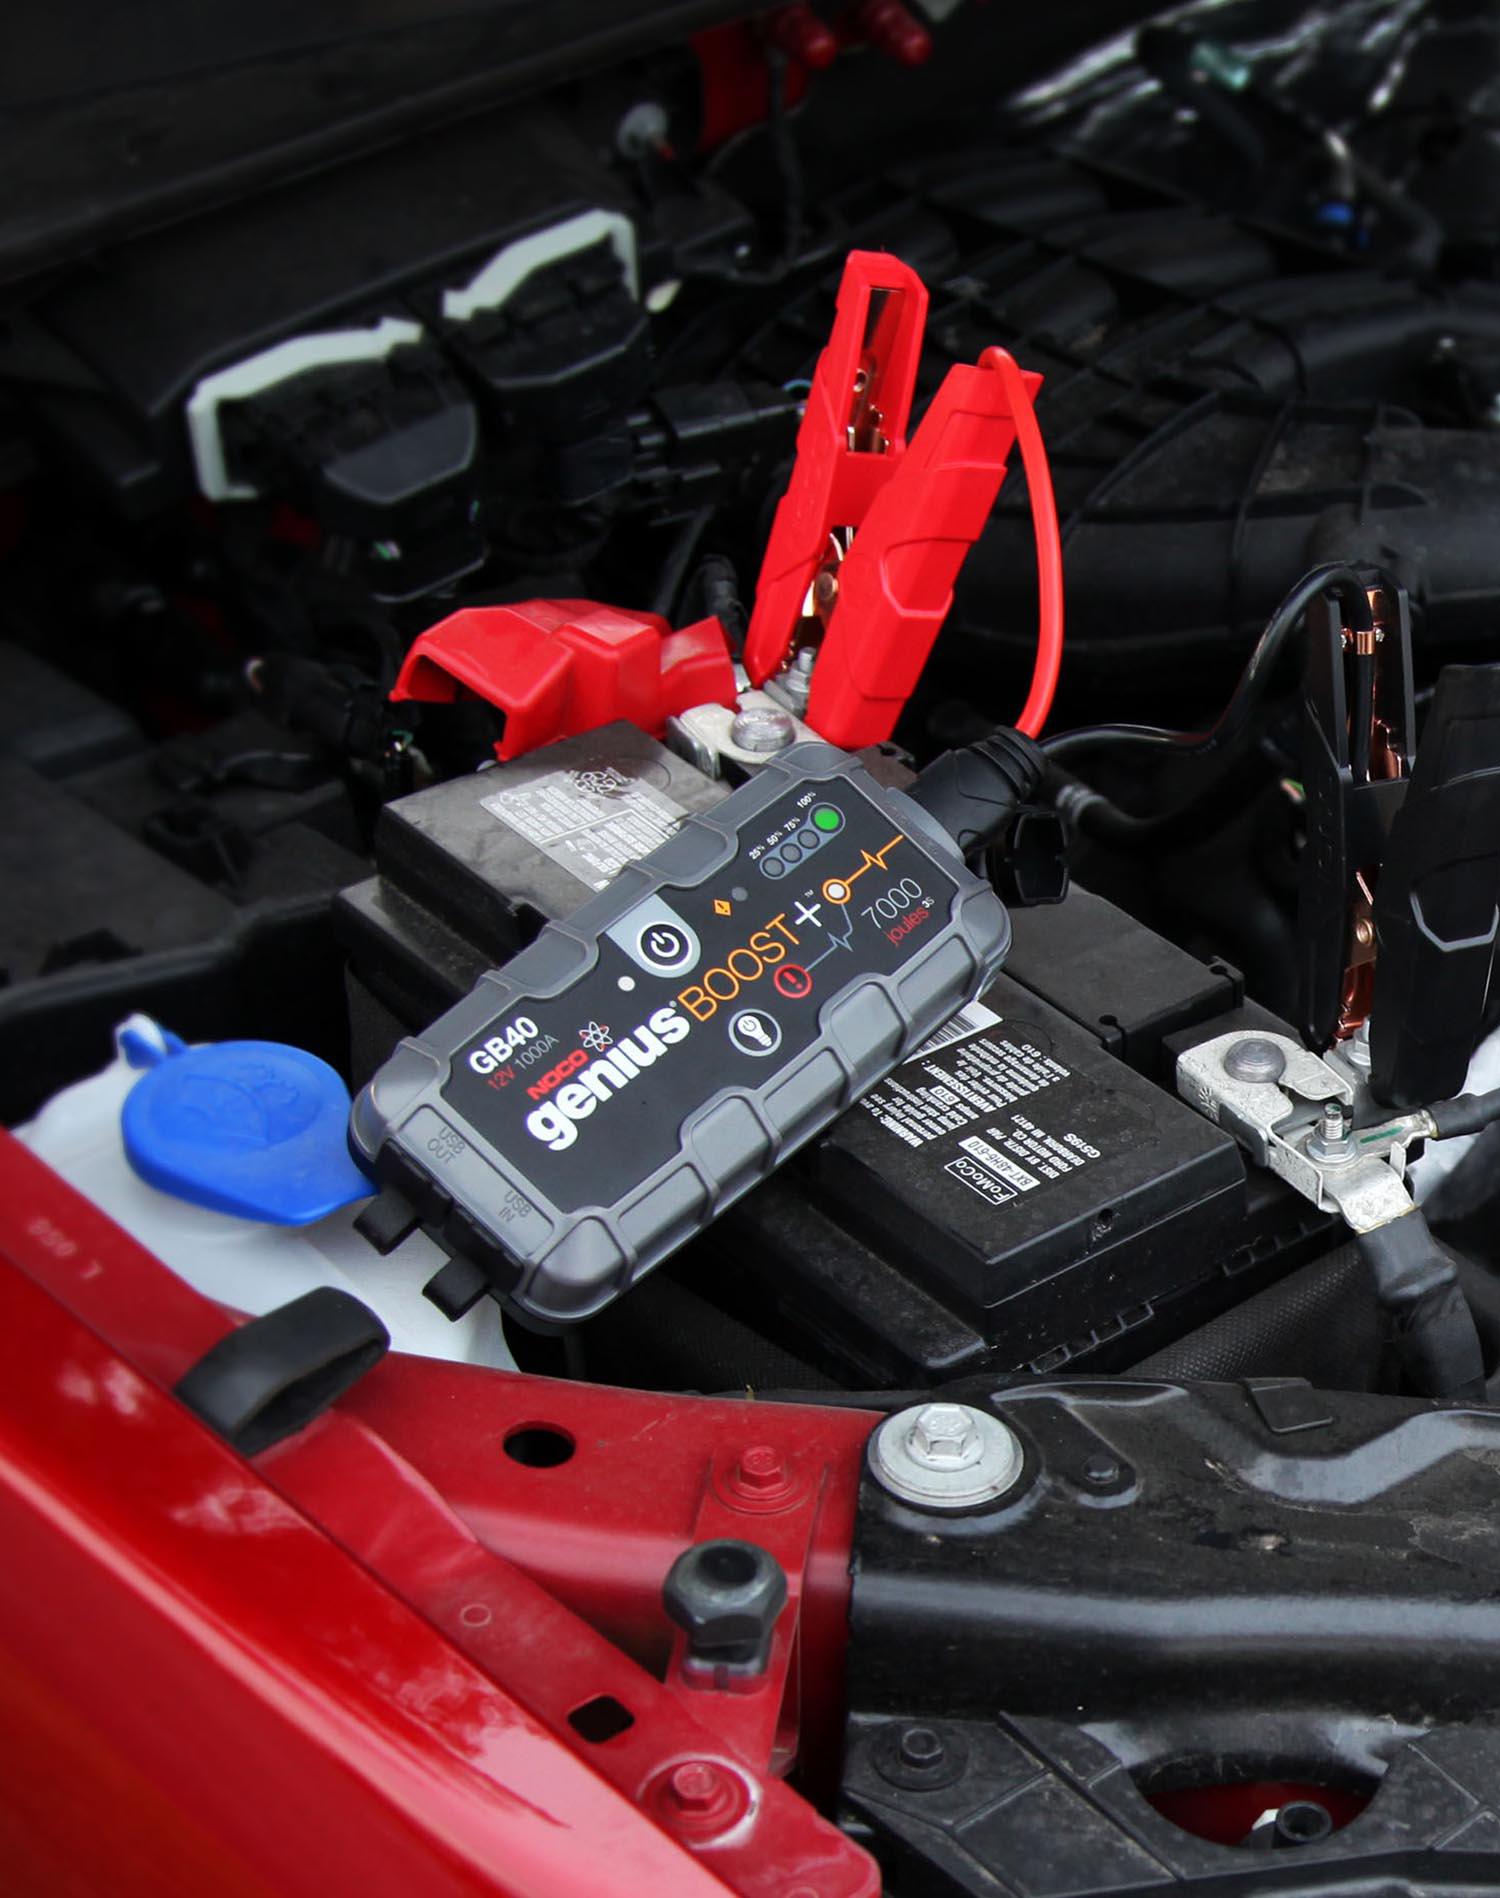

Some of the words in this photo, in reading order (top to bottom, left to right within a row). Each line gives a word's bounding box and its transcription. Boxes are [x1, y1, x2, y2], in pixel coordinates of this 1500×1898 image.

[766, 831, 782, 847] 50%
[784, 817, 800, 832] 75%
[797, 791, 816, 809] 100%
[861, 878, 922, 929] 7000
[469, 1016, 539, 1075] GB40
[488, 1065, 517, 1091] 12V
[514, 1034, 560, 1070] 1000A
[526, 1049, 590, 1100] NOCO
[526, 1007, 691, 1151] genius
[933, 1087, 956, 1102] 610
[427, 1138, 455, 1164] OUT
[438, 1126, 466, 1154] USB
[955, 1160, 1011, 1202] FoMoCo
[1048, 1156, 1073, 1173] FORD
[499, 1206, 515, 1222] IN
[504, 1190, 532, 1218] USB
